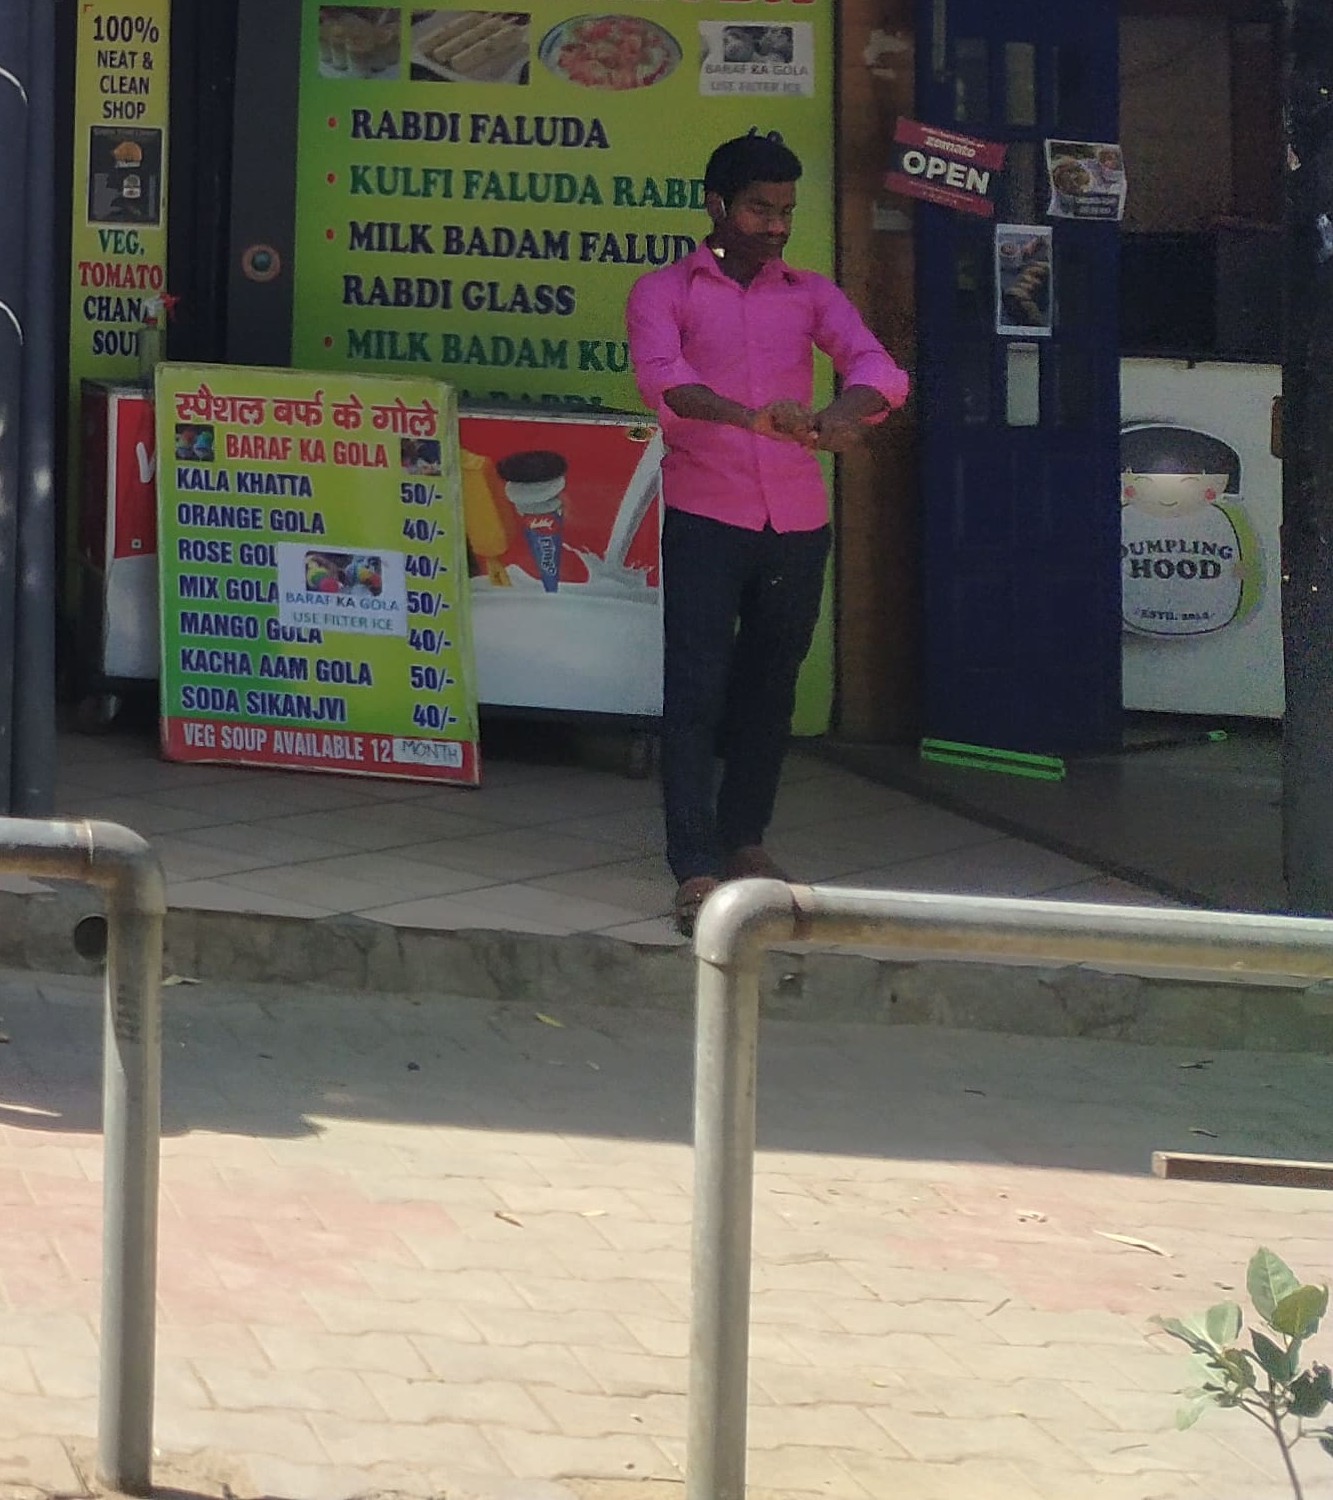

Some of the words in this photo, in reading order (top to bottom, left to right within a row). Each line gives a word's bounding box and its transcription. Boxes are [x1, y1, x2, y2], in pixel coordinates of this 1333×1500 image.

[93, 15, 160, 44] 100%
[97, 50, 136, 70] NEAT
[142, 52, 154, 71] &
[100, 75, 149, 96] CLEAN
[102, 100, 147, 120] SHOP
[351, 108, 461, 143] RABDI
[470, 114, 611, 150] FALUDA
[349, 165, 454, 199] KULFI
[463, 169, 604, 206] FALUDA
[901, 150, 990, 194] OPEN
[98, 230, 145, 256] VEG.
[349, 222, 433, 256] MILK
[442, 226, 570, 261] BADAM
[78, 261, 163, 290] TOMATO
[342, 275, 453, 310] RABDI
[462, 280, 576, 315] GLASS
[273, 389, 325, 428] बर्फ
[331, 394, 363, 430] के
[371, 397, 438, 437] गोले
[226, 434, 293, 461] BARAF
[299, 438, 326, 464] KA
[333, 441, 389, 468] GOLA
[177, 468, 229, 493] KALA
[237, 472, 312, 498] KHATTA
[400, 483, 443, 507] 50/-
[178, 503, 263, 530] ORANGE
[270, 509, 325, 534] GOLA
[402, 519, 444, 542] 40/-
[1129, 559, 1222, 580] HOOD
[182, 649, 252, 676] KACHA
[259, 654, 308, 681] AAM
[316, 659, 372, 686] GOLA
[182, 686, 239, 713] SODA
[246, 691, 347, 722] SIKANJVI
[183, 723, 216, 747] VEG
[221, 727, 267, 752] SOUP
[273, 731, 365, 761] AVAILABLE
[371, 739, 393, 763] 12
